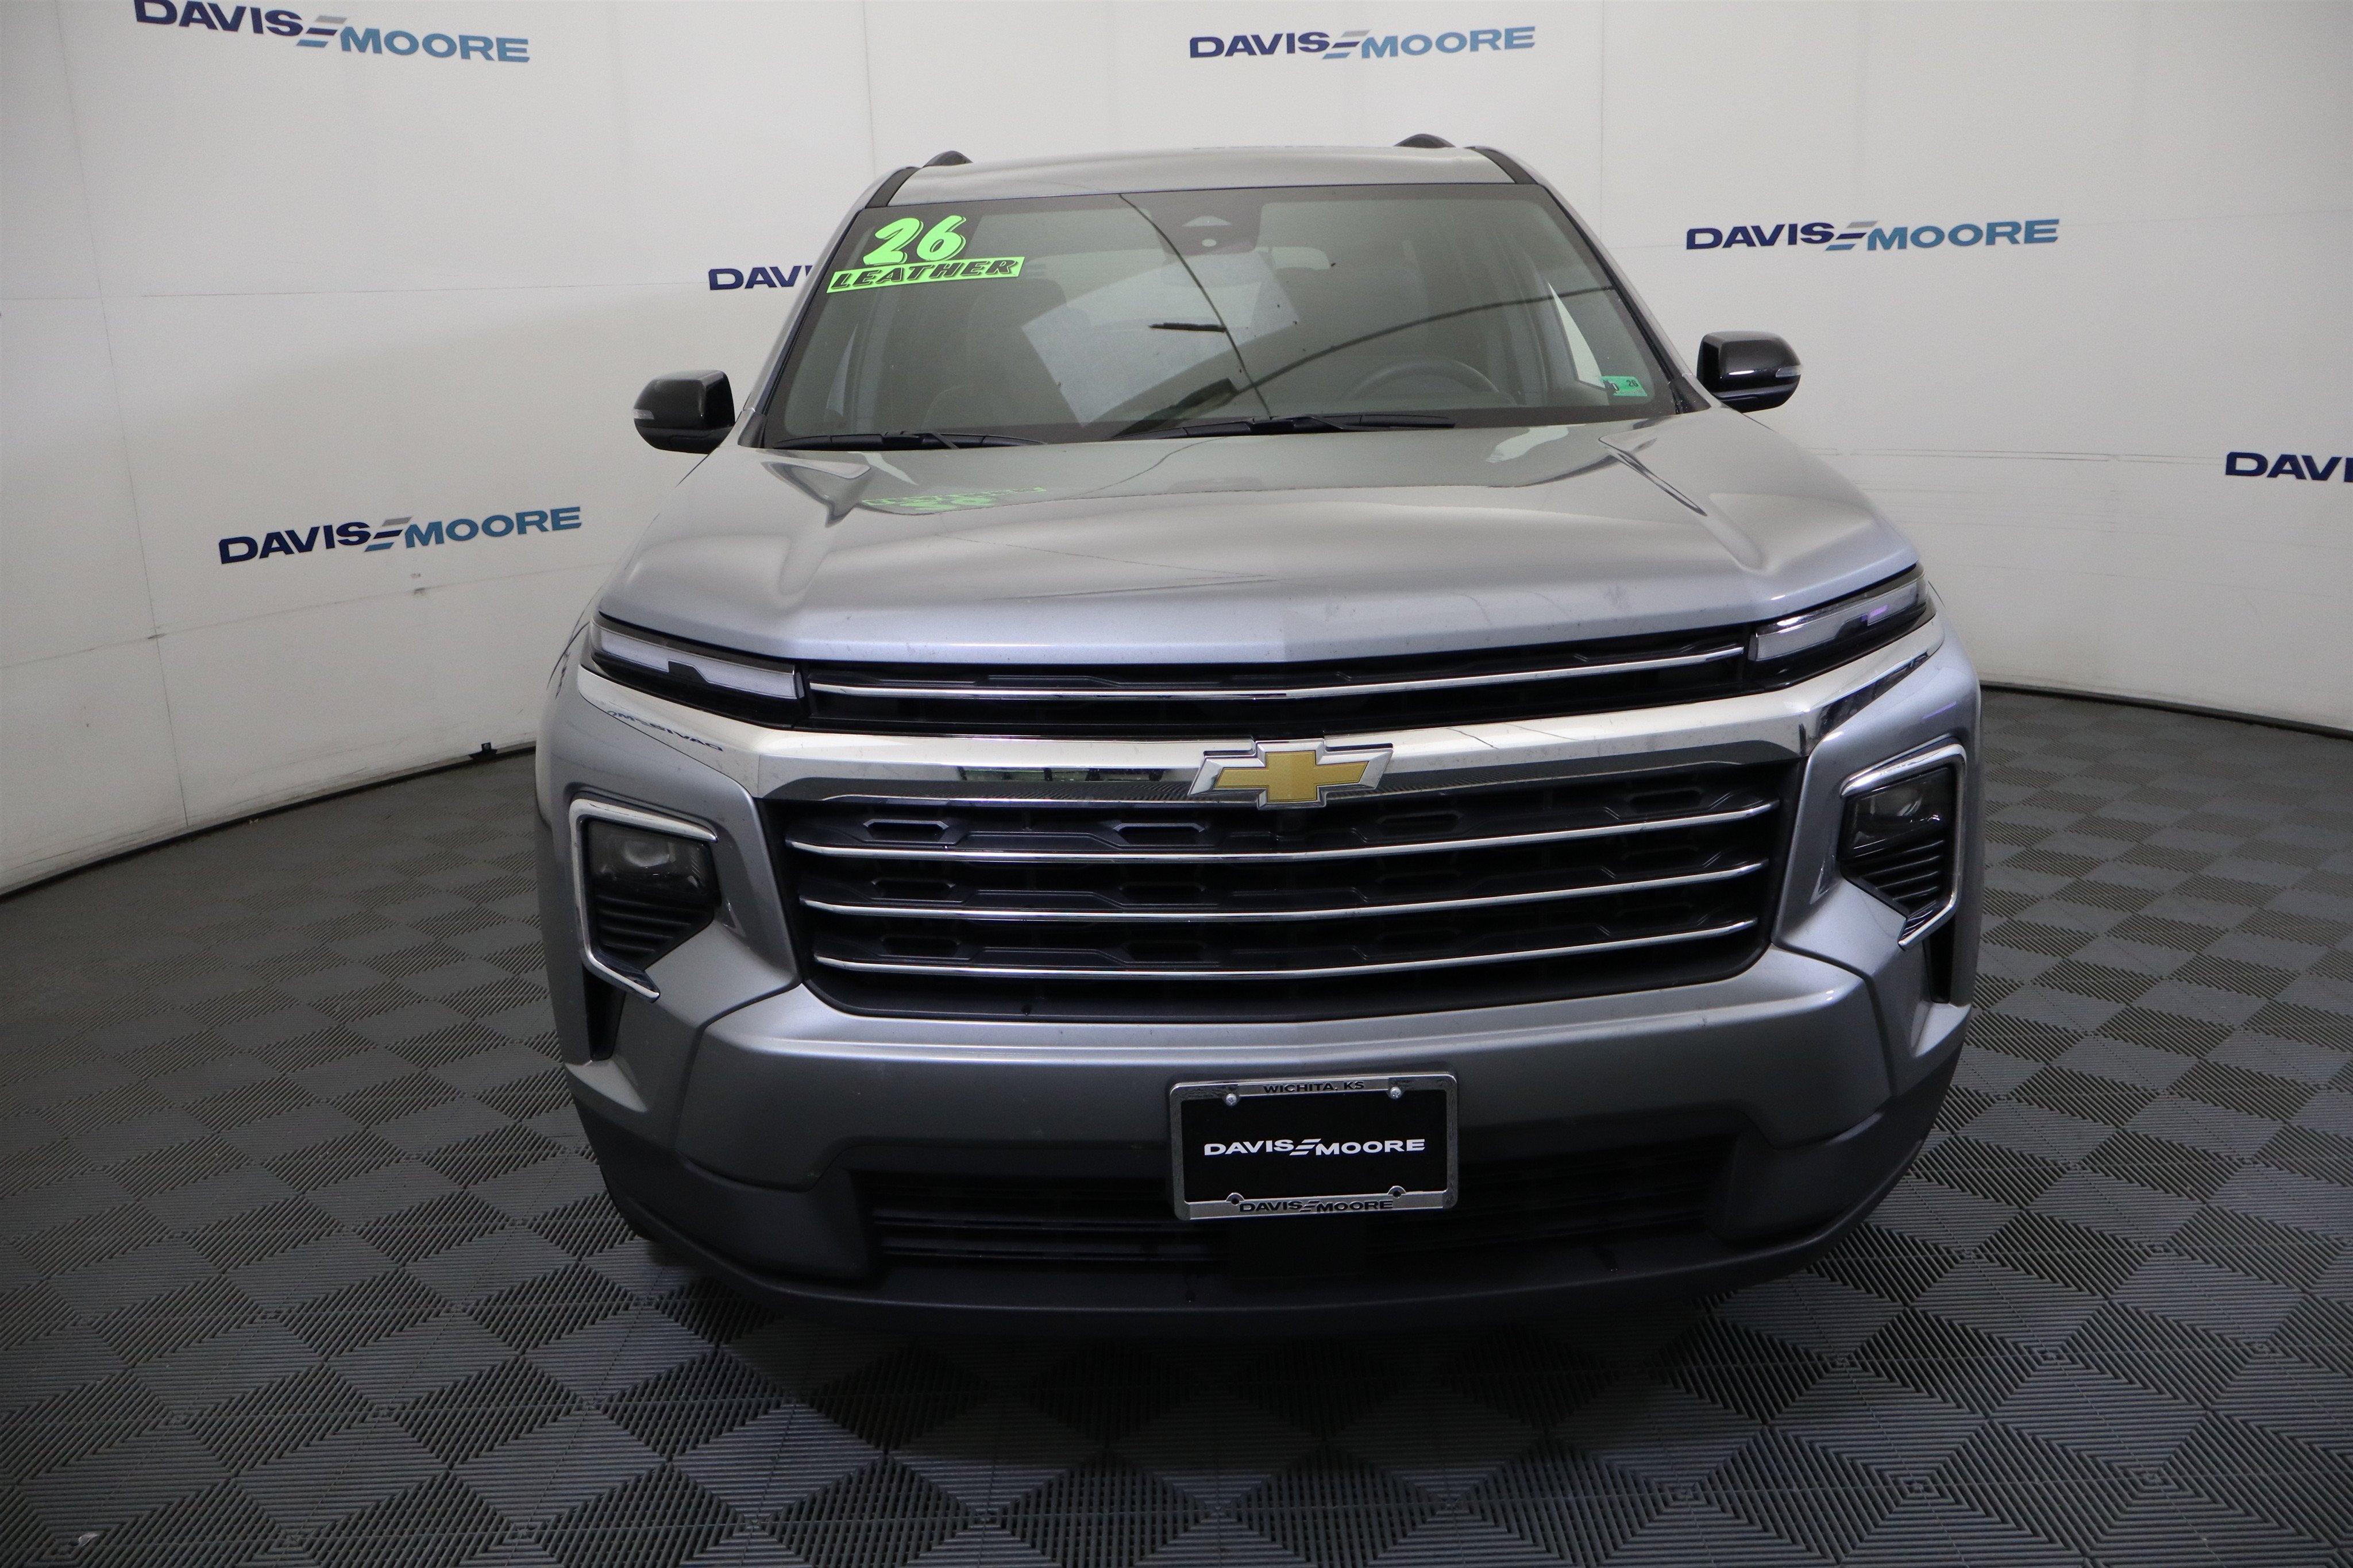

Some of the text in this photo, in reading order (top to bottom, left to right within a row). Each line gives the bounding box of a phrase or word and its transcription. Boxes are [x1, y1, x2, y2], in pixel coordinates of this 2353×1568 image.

[136, 0, 530, 63] DAVIS MOORE
[1190, 26, 1536, 59] DAVIS MOORE
[863, 215, 967, 266] 26
[1686, 219, 2059, 250] DAVIS MOORE
[708, 265, 813, 291] DAV
[831, 260, 1019, 289] LEATHER
[218, 506, 581, 564] DAVIS MOORE
[1344, 1081, 1365, 1090] KS
[1204, 1138, 1425, 1156] DAVIS MOORE
[1239, 1200, 1393, 1212] DAVIS MOORE
